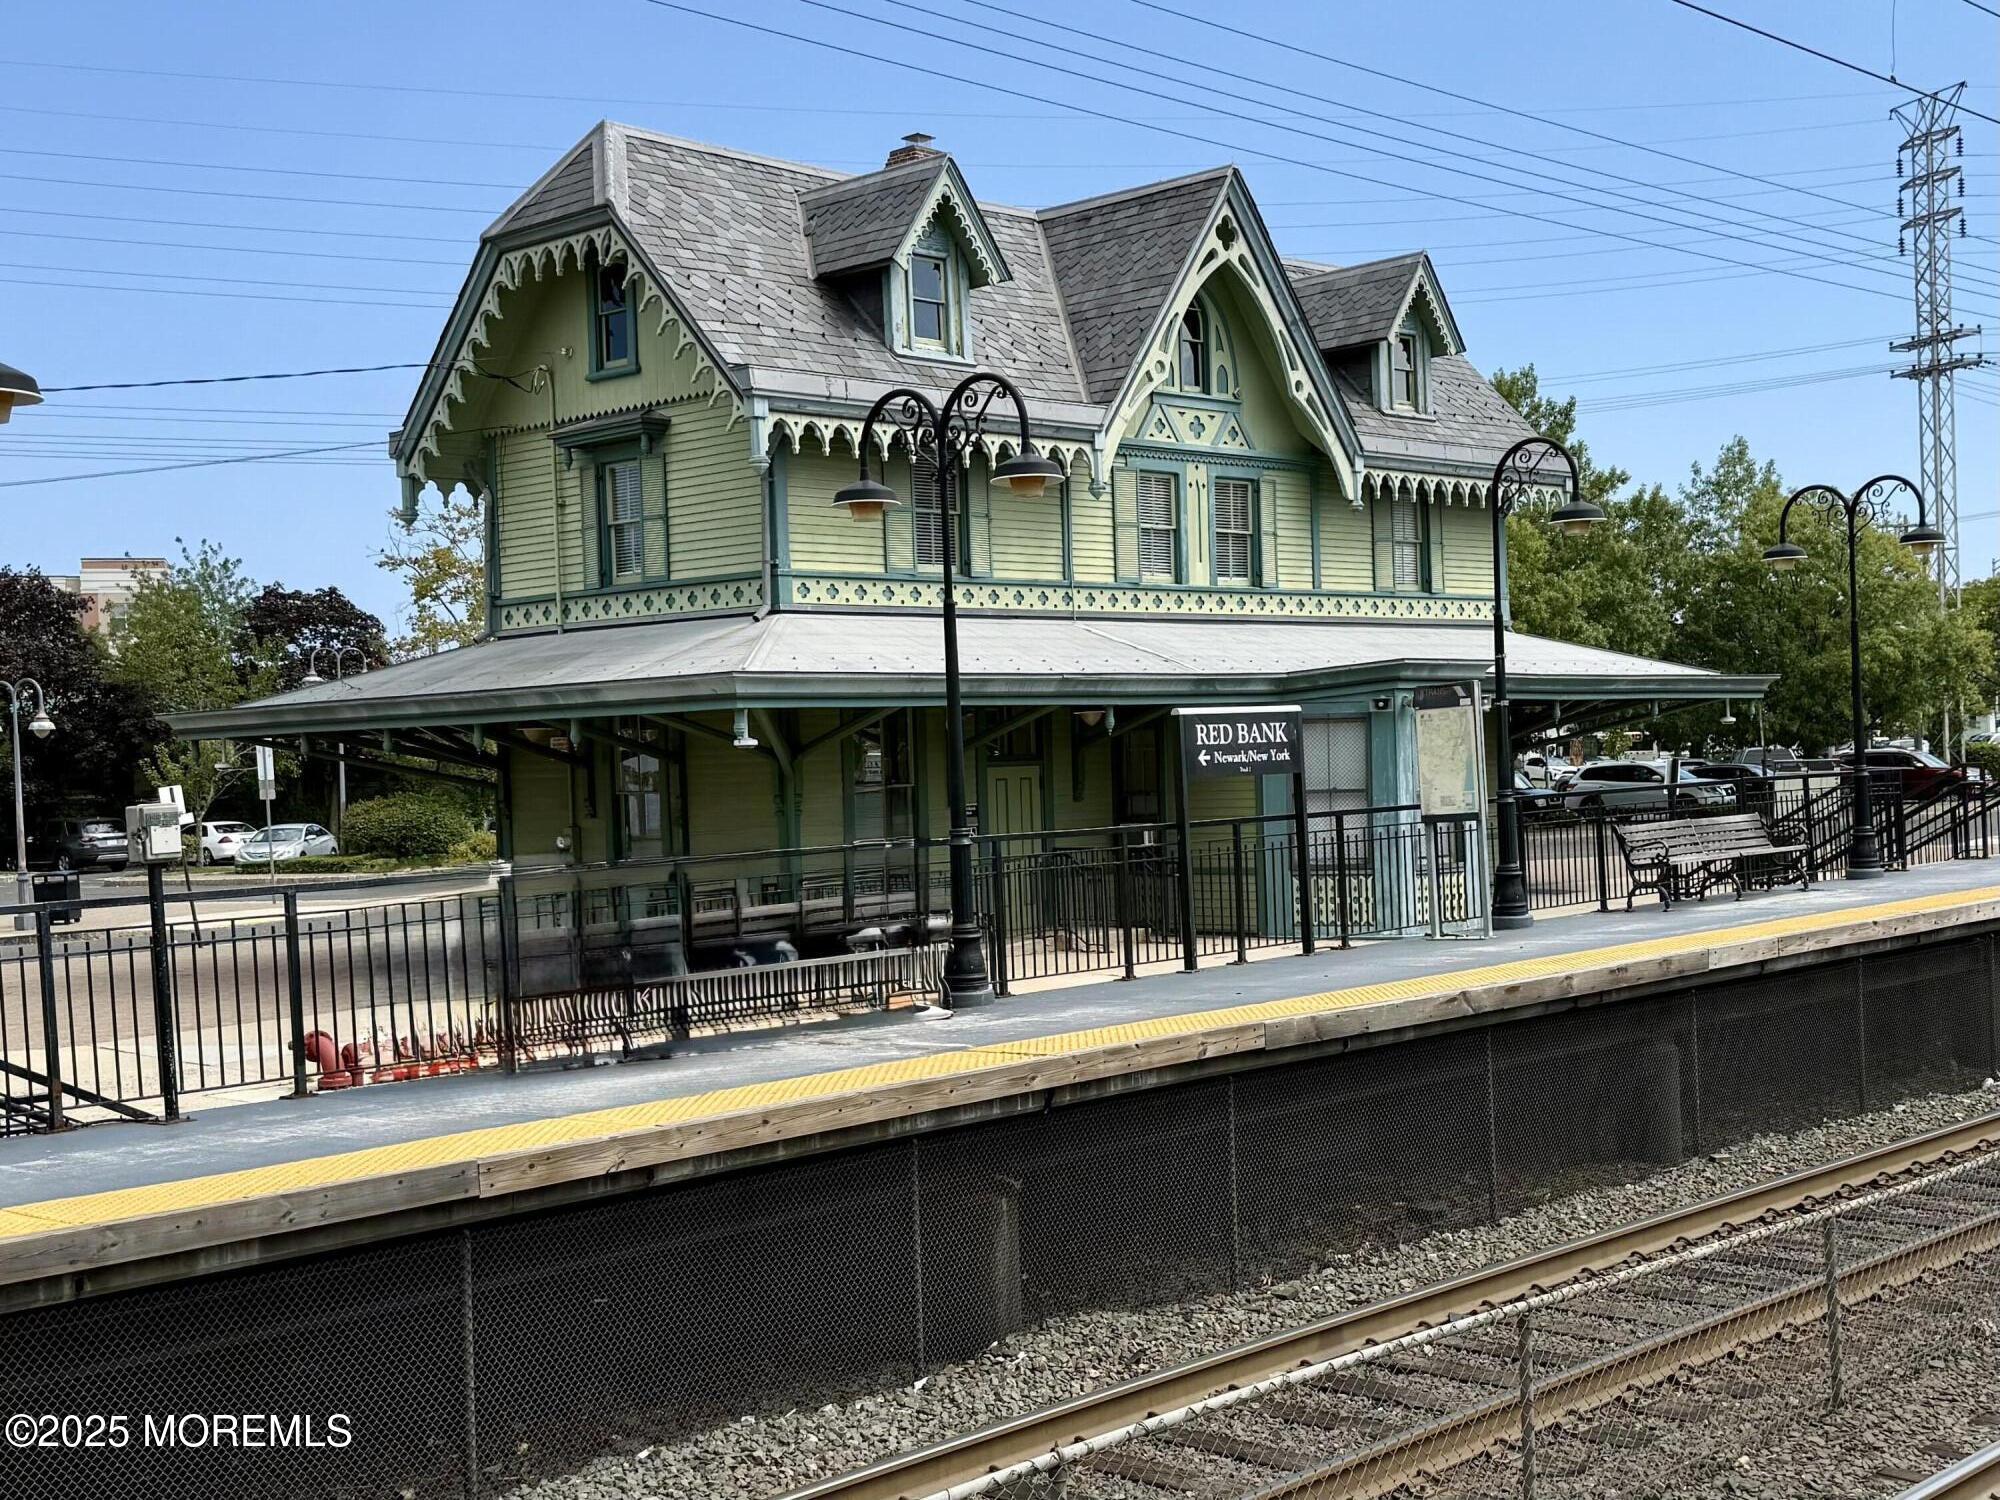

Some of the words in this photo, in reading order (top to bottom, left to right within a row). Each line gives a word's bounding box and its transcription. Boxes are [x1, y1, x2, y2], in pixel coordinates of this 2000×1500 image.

[1195, 723, 1233, 745] RED
[1236, 722, 1289, 744] BANK
[1214, 749, 1268, 764] Newark/New
[1270, 748, 1291, 761] York
